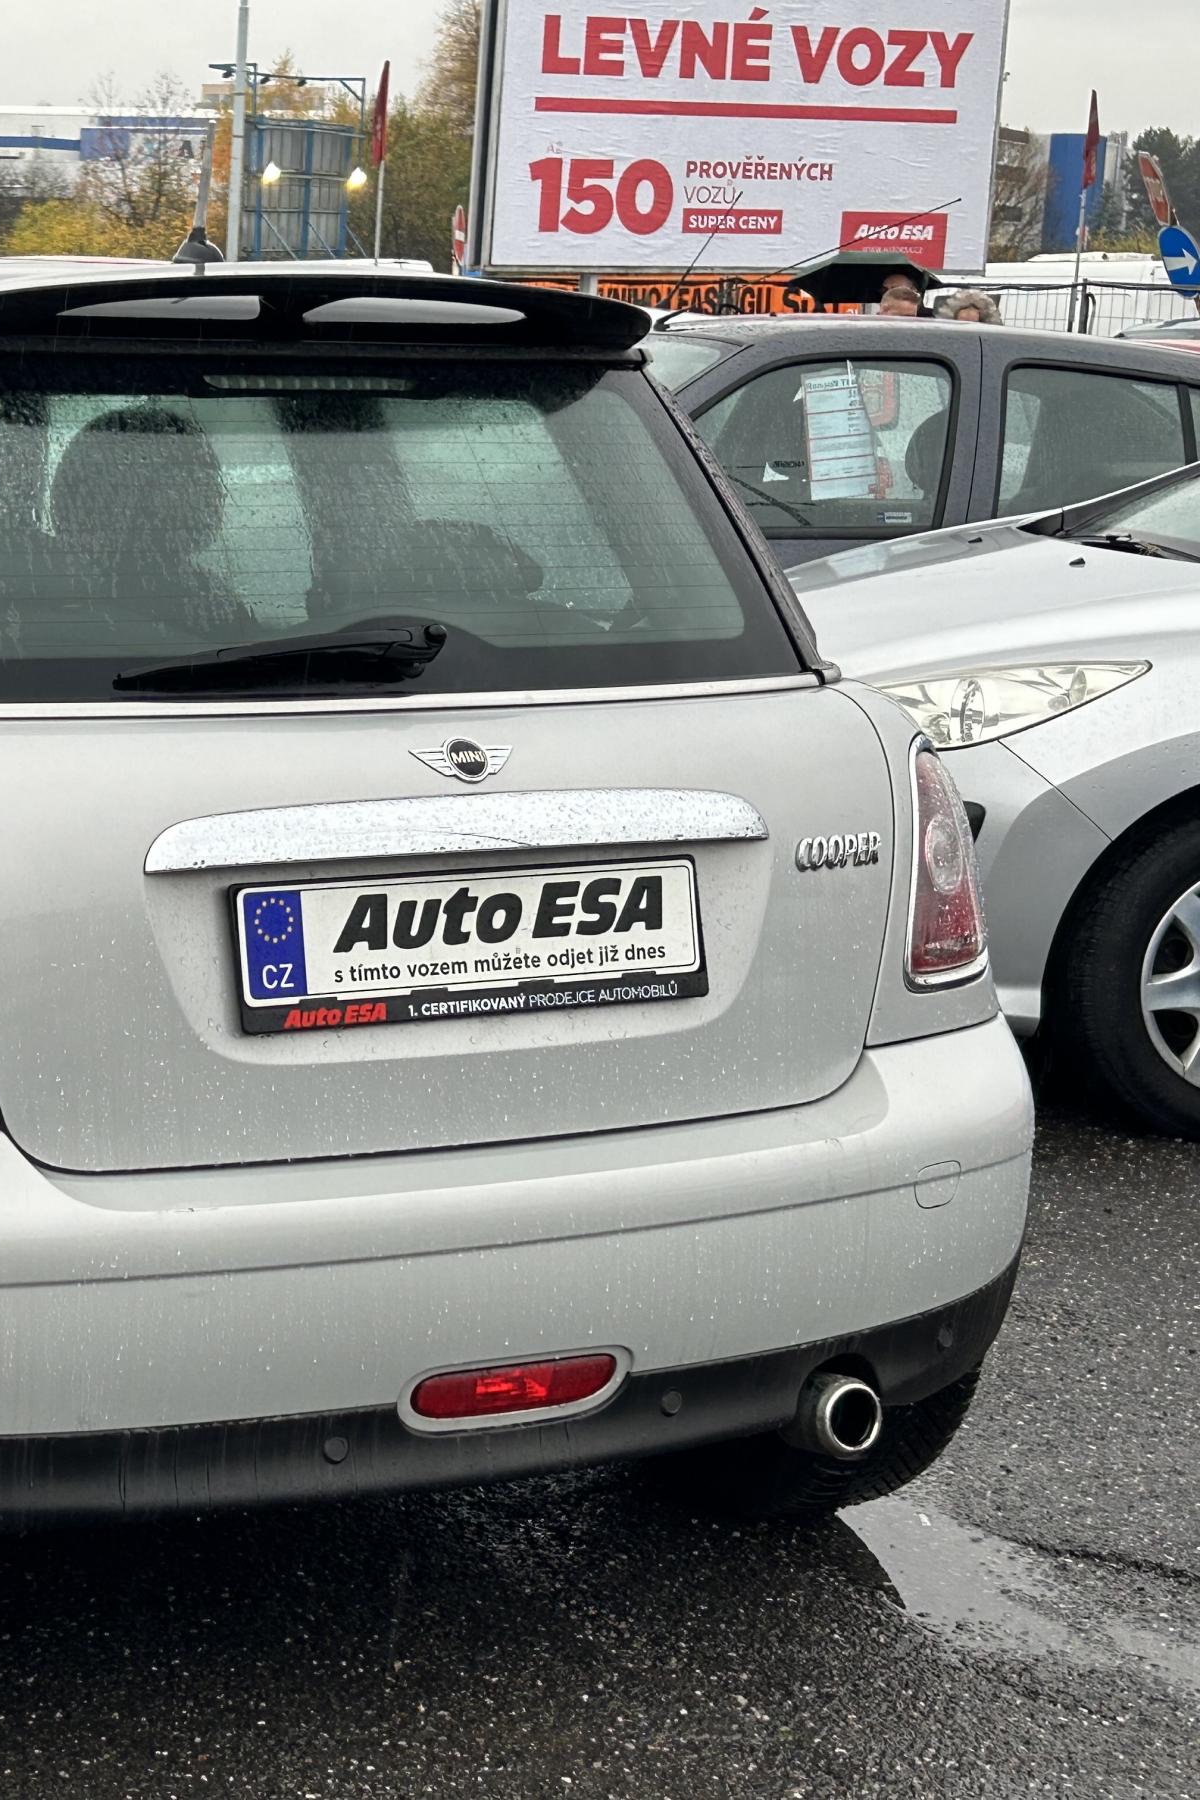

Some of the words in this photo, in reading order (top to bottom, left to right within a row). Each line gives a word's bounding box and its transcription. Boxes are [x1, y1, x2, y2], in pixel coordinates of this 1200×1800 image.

[541, 7, 773, 82] LEVNÉ
[790, 25, 974, 88] VOZY
[686, 155, 833, 182] PROVĚŘENÝCH
[529, 157, 673, 235] 150
[684, 179, 736, 204] VOZŮ
[688, 214, 735, 229] SUPER
[739, 215, 778, 230] CENY
[854, 224, 899, 240] Auto
[900, 225, 934, 240] ESA
[450, 750, 486, 764] MINI
[795, 831, 881, 871] COOPER
[333, 887, 522, 953] Auto
[532, 876, 662, 938] ESA
[262, 963, 295, 989] CZ
[334, 969, 344, 983] s
[350, 962, 400, 982] tímto
[407, 960, 468, 978] vozem
[474, 952, 541, 973] můžete
[547, 949, 594, 974] odjet
[599, 945, 619, 966] již
[625, 944, 666, 961] dnes
[408, 1004, 418, 1017] 1.
[421, 992, 525, 1016] CERTIFIKOVANÝ
[529, 989, 595, 1007] PRODEJCE
[598, 980, 678, 1001] AUTOMOBILŮ
[284, 1008, 344, 1029] Auto
[344, 1002, 387, 1024] ESA
